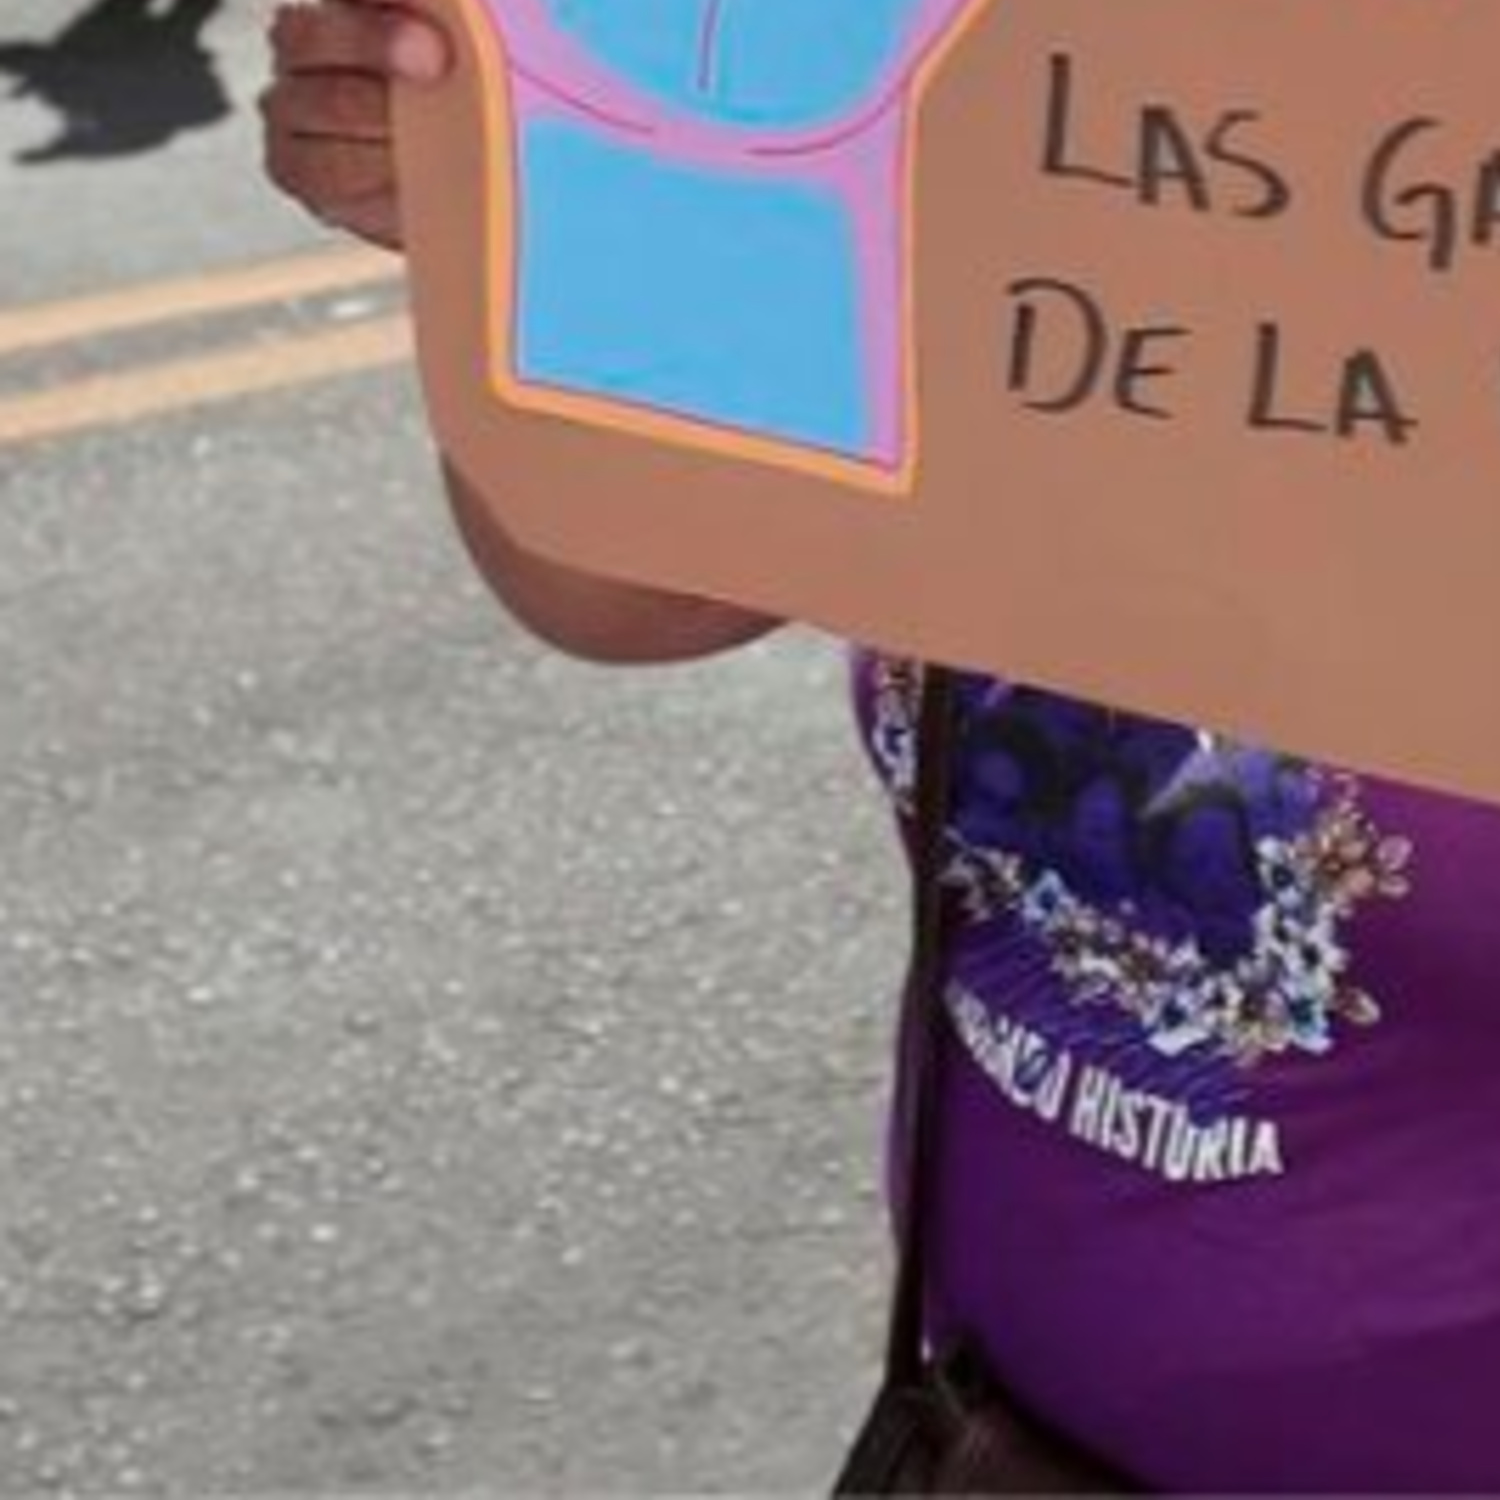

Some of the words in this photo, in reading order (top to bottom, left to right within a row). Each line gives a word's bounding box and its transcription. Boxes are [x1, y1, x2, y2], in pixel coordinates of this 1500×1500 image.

[1040, 52, 1290, 219] LAS
[1006, 277, 1189, 419] DE
[1246, 322, 1418, 445] LA
[1069, 1064, 1282, 1182] HISTORIA
